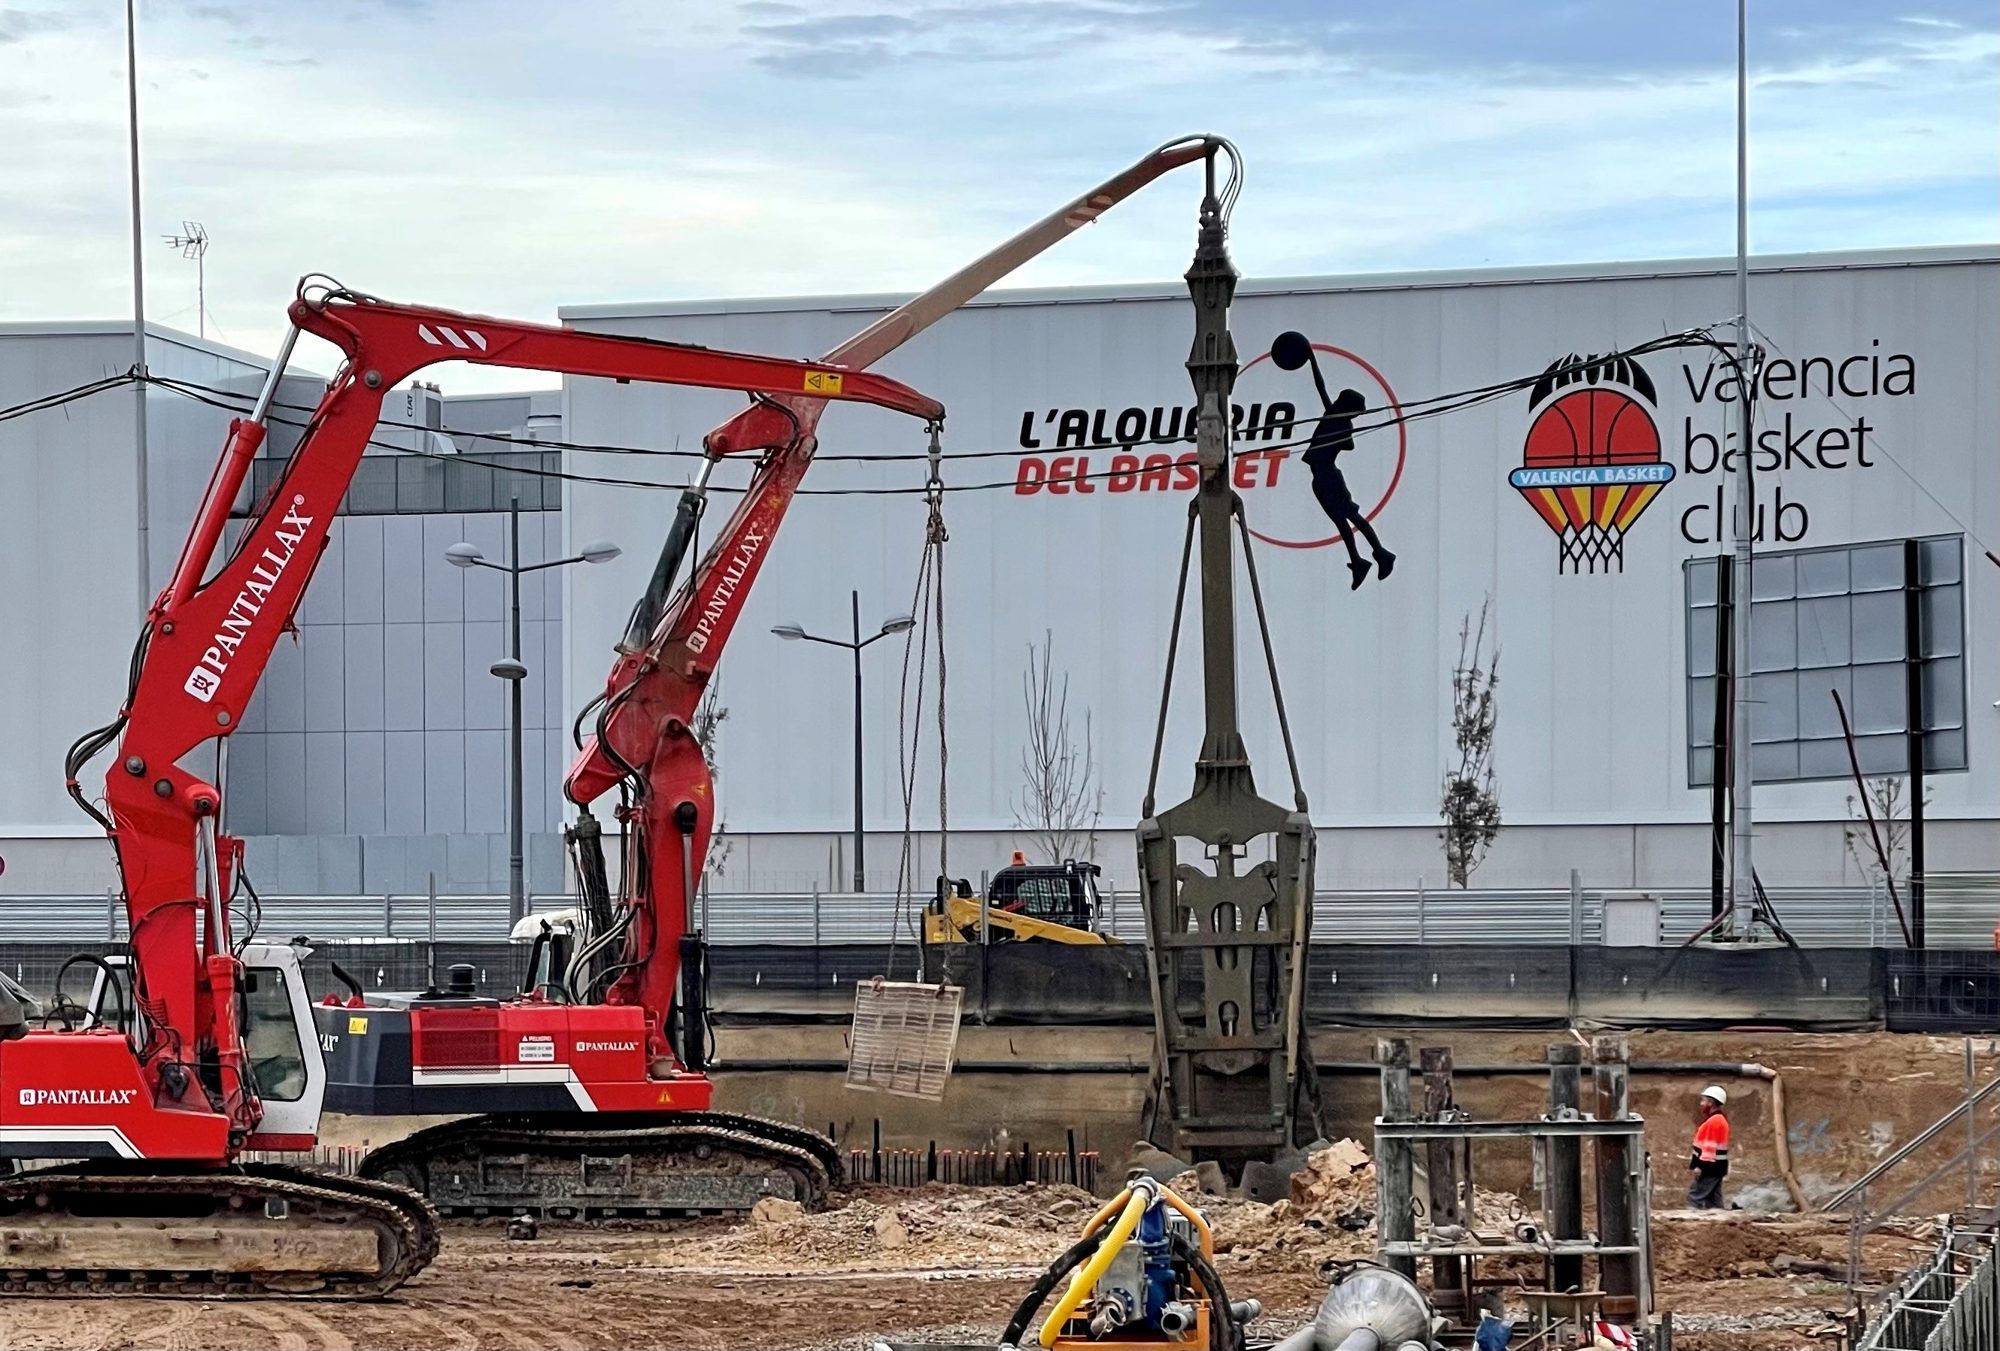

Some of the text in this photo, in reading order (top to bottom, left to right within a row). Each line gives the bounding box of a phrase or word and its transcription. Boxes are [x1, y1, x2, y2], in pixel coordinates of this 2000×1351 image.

[1015, 449, 1291, 495] DEL BASET
[1519, 467, 1666, 485] VALENCIA BASKET
[1681, 485, 1809, 544] club
